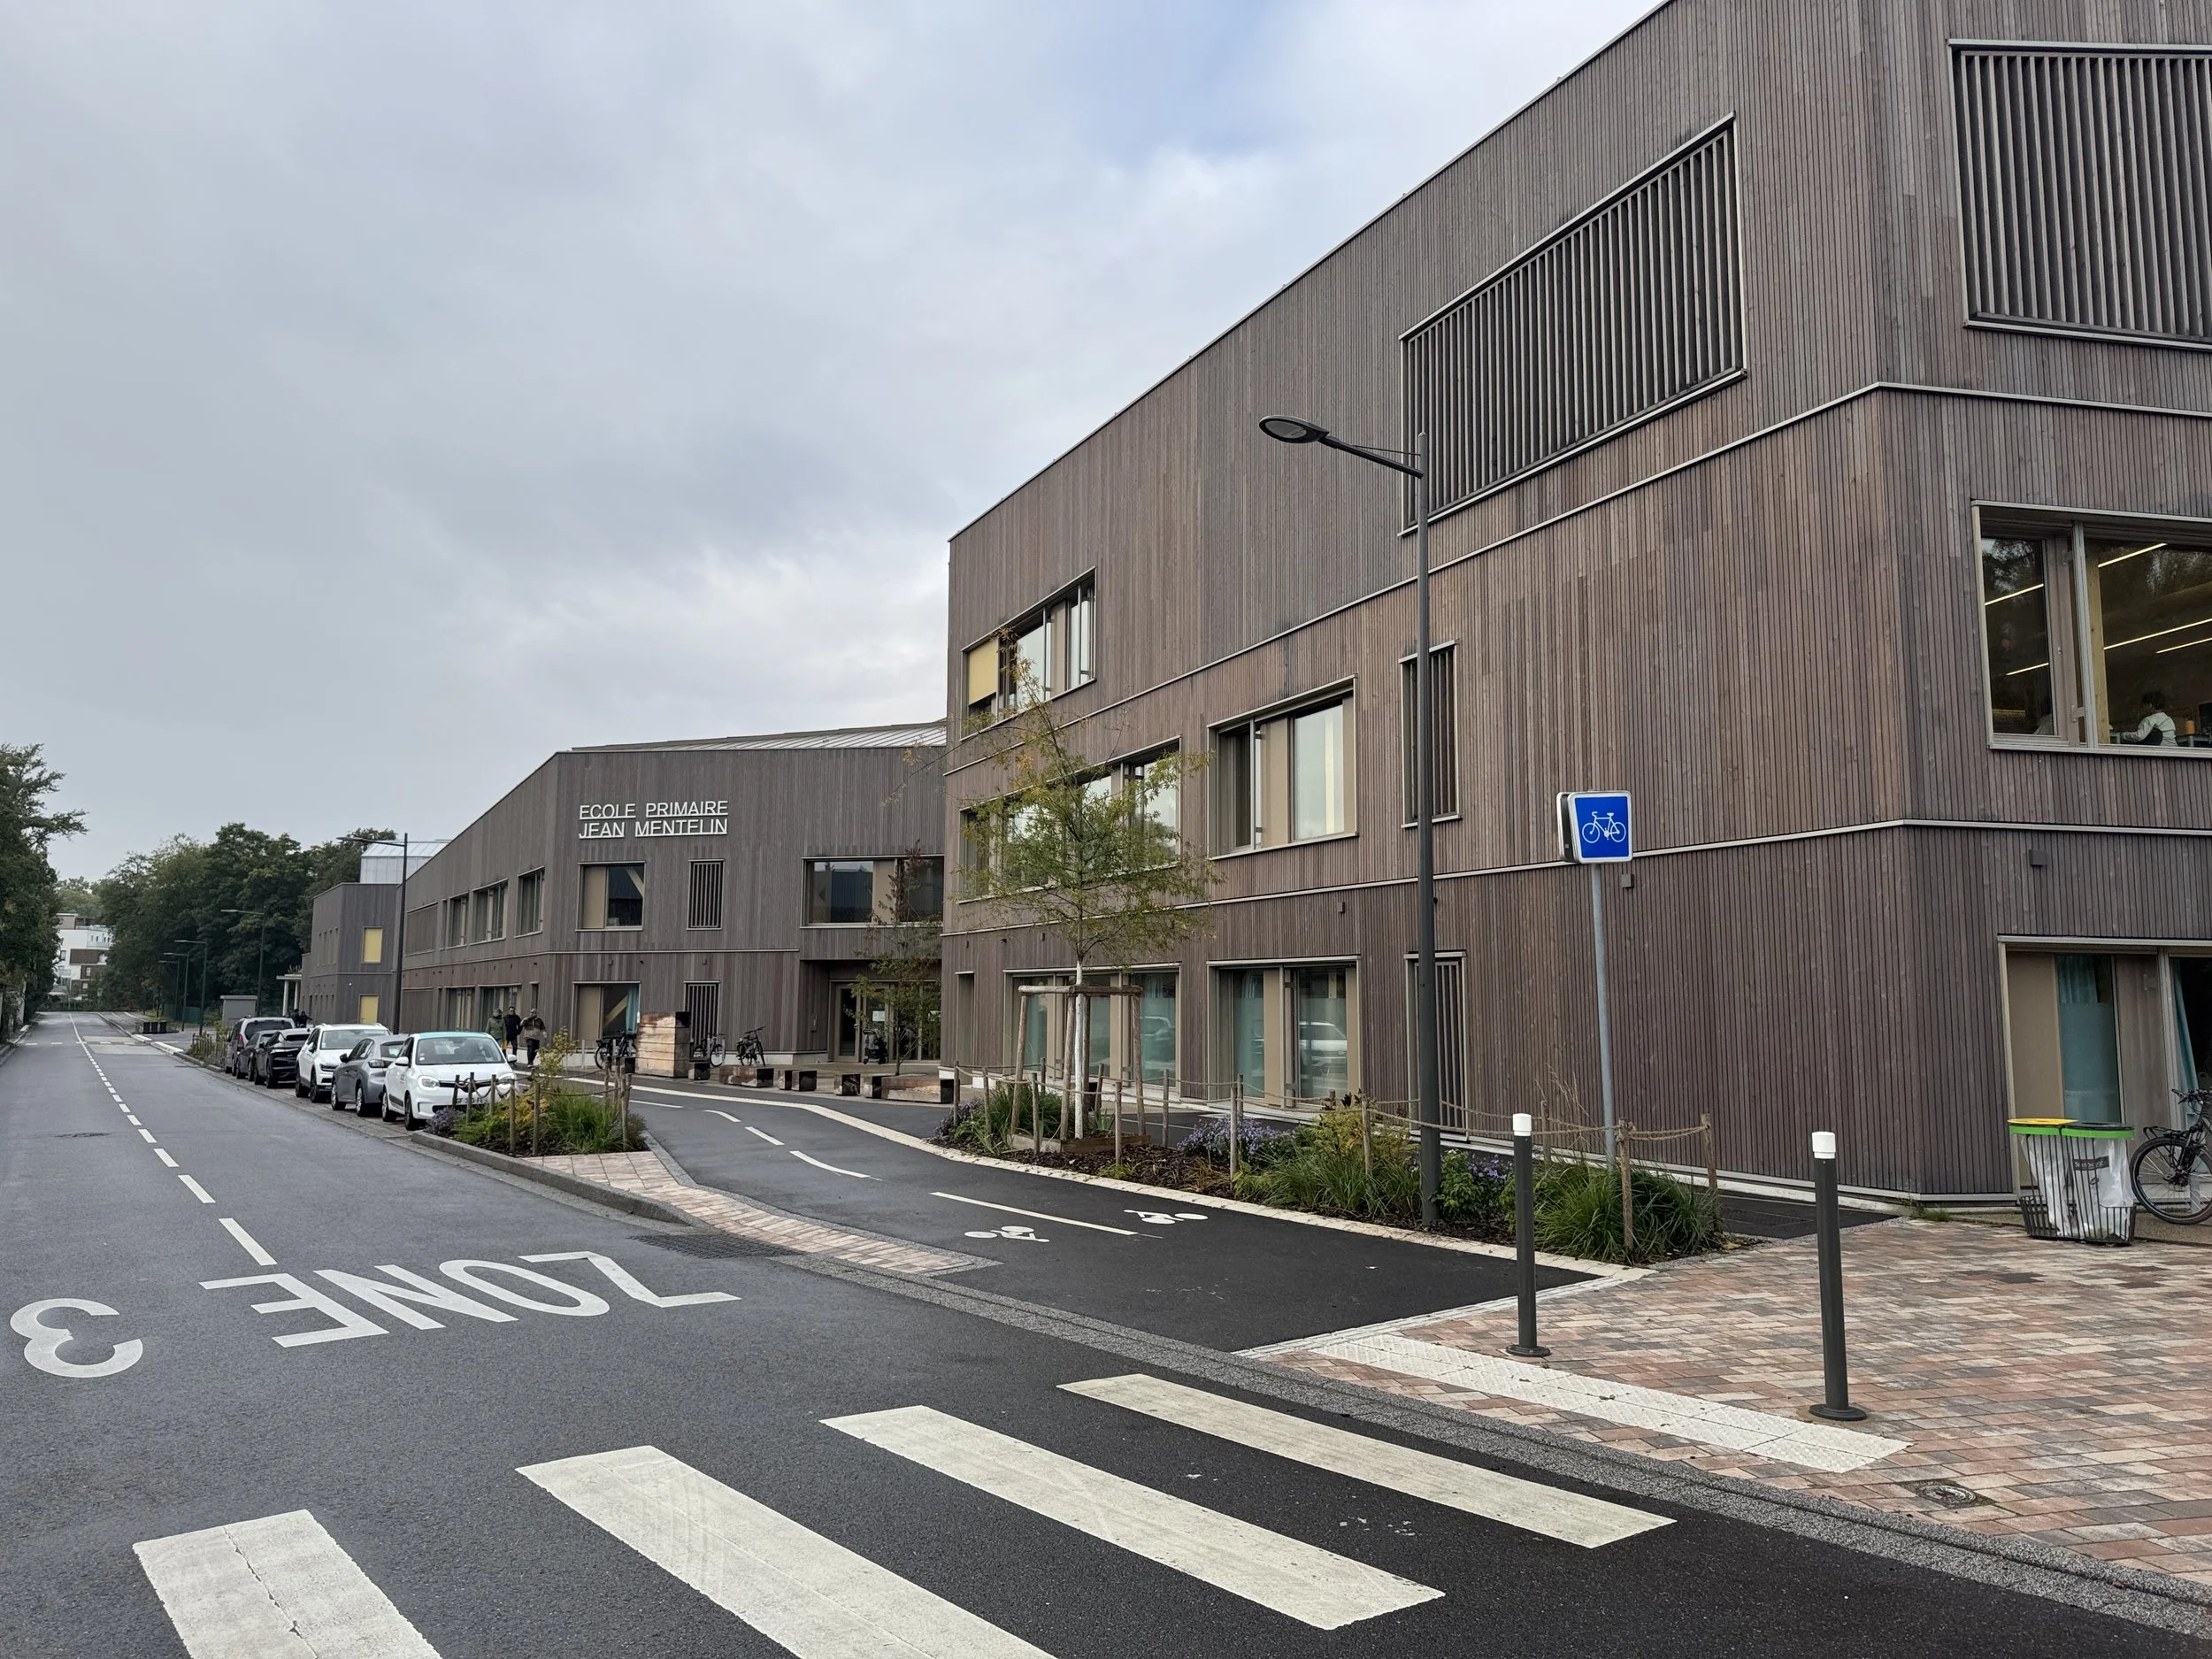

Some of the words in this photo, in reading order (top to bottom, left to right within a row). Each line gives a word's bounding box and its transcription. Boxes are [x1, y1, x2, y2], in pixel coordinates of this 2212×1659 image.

[580, 803, 636, 819] ECOLE
[645, 800, 728, 818] PRIMAIRE
[579, 822, 625, 839] JEAN
[634, 818, 727, 837] MENTELIN
[199, 1250, 742, 1348] ZONE
